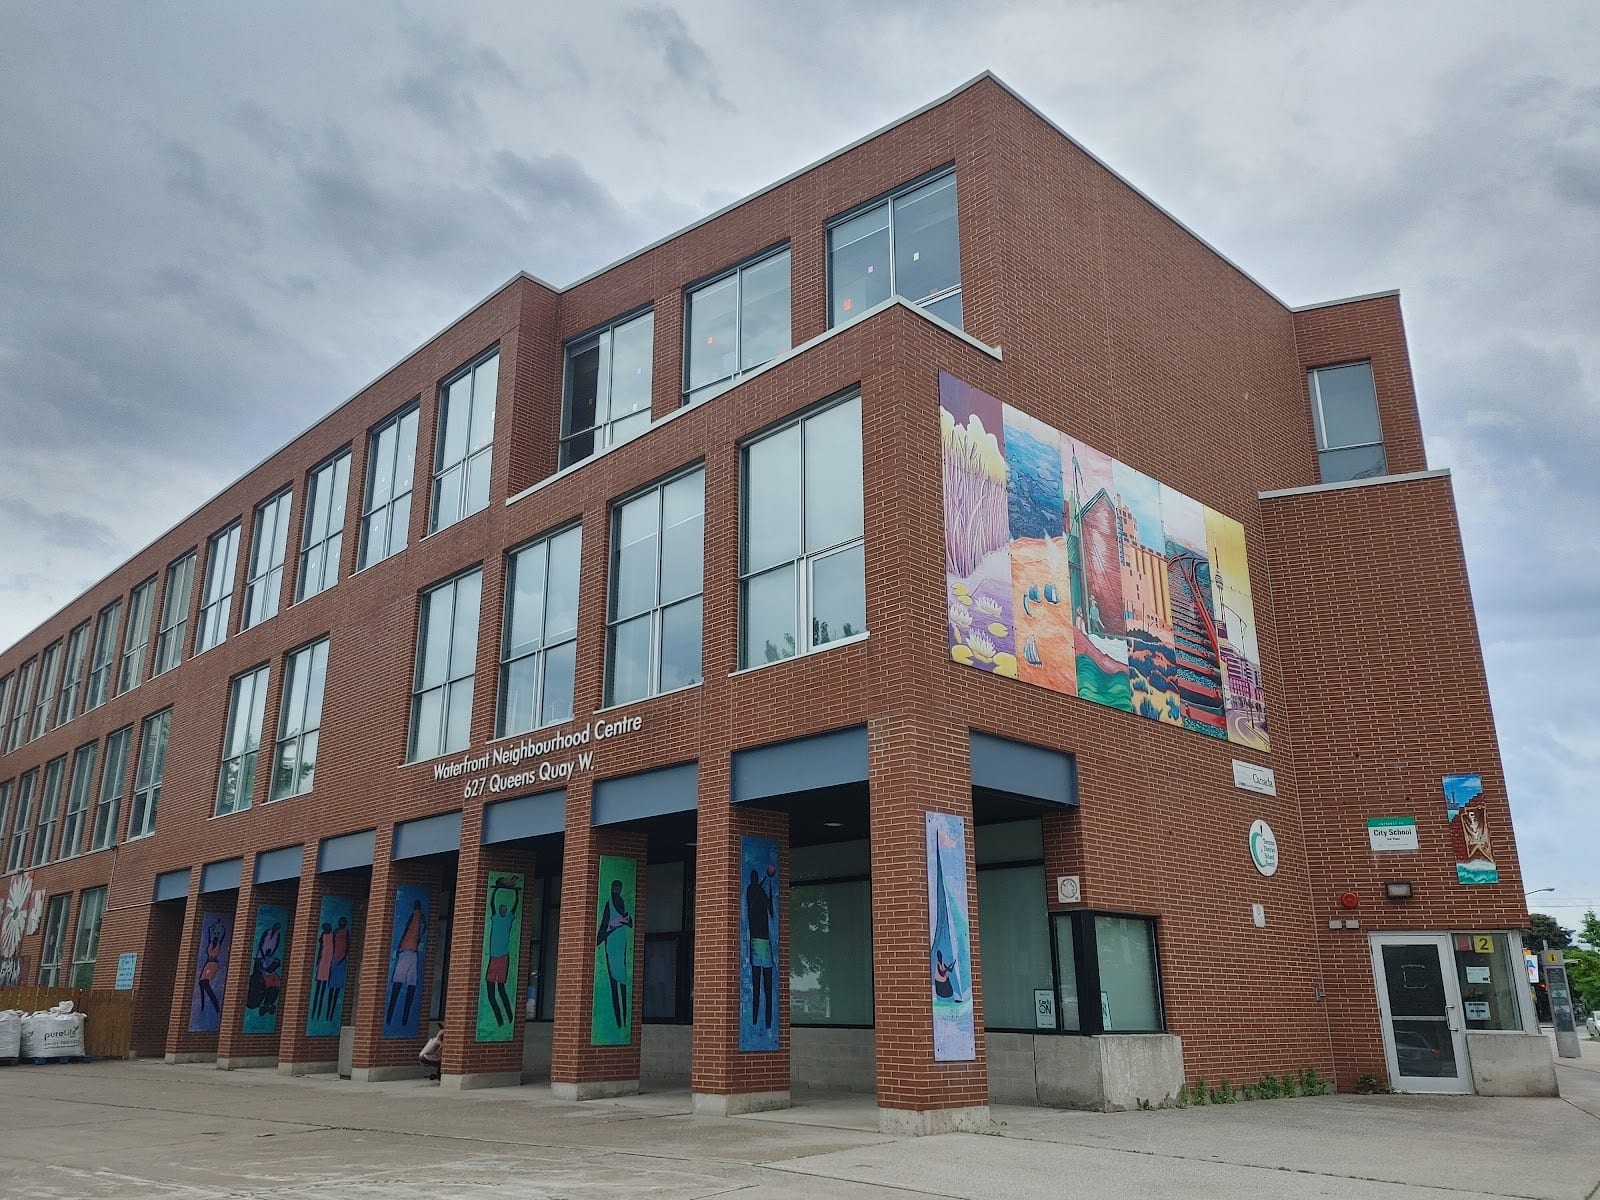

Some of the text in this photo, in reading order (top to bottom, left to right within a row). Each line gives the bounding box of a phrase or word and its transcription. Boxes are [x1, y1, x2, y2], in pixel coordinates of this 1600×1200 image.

[434, 716, 643, 781] Waterfront Neighbourhood Centre
[464, 751, 595, 799] 627 Queens Quay W.
[1373, 828, 1412, 837] City School
[1479, 937, 1489, 951] 2
